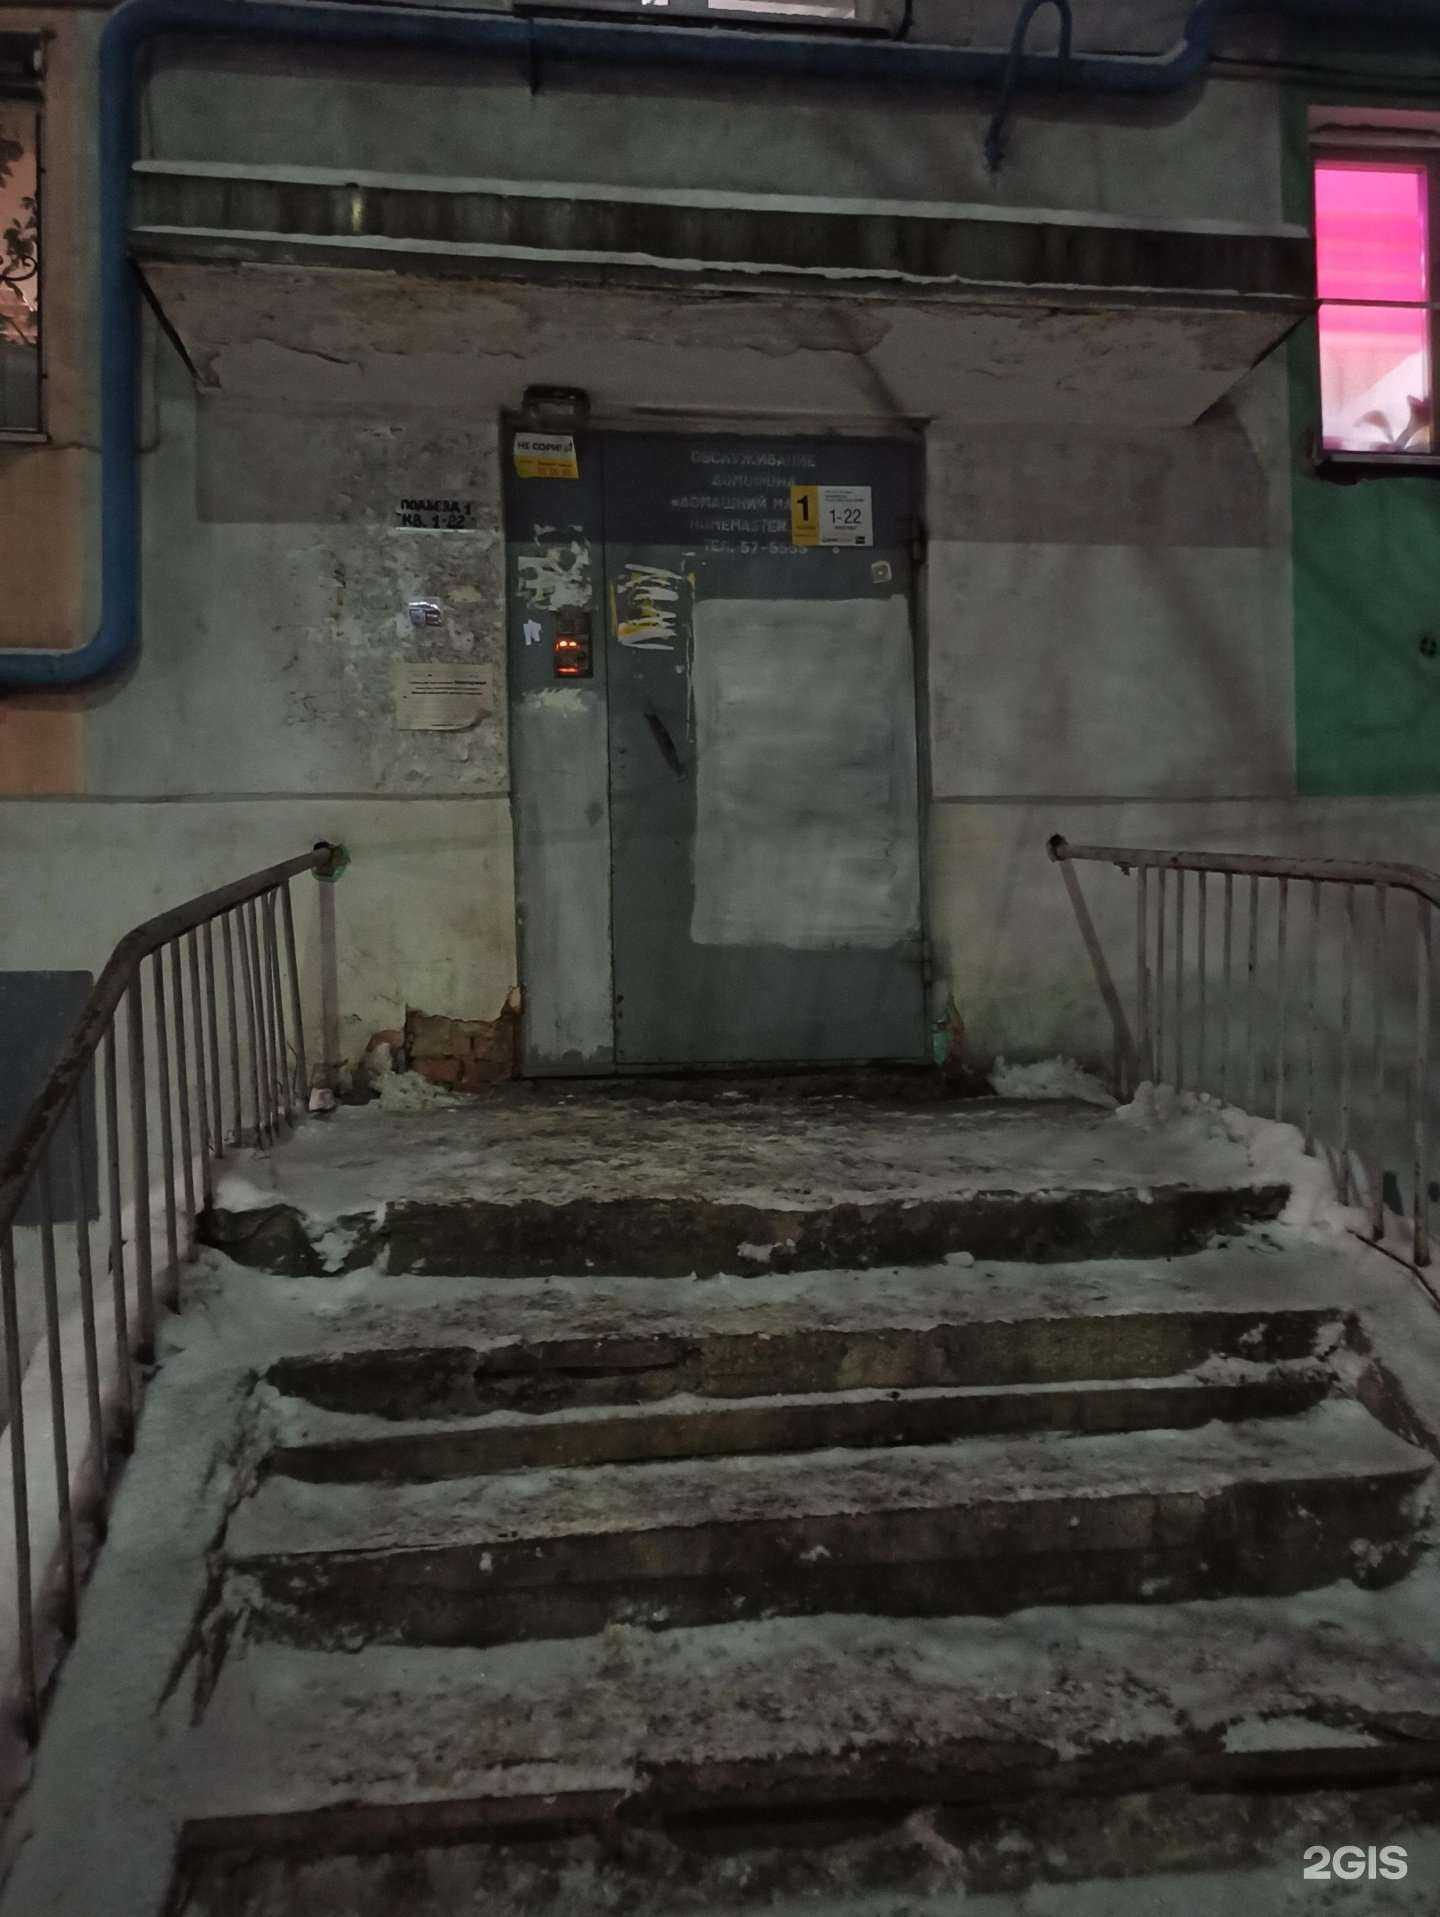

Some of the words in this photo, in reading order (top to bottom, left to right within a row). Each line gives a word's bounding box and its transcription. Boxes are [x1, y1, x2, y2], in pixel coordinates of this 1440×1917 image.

[517, 441, 530, 450] НЕ
[797, 495, 809, 521] 1
[829, 508, 862, 525] 1-22
